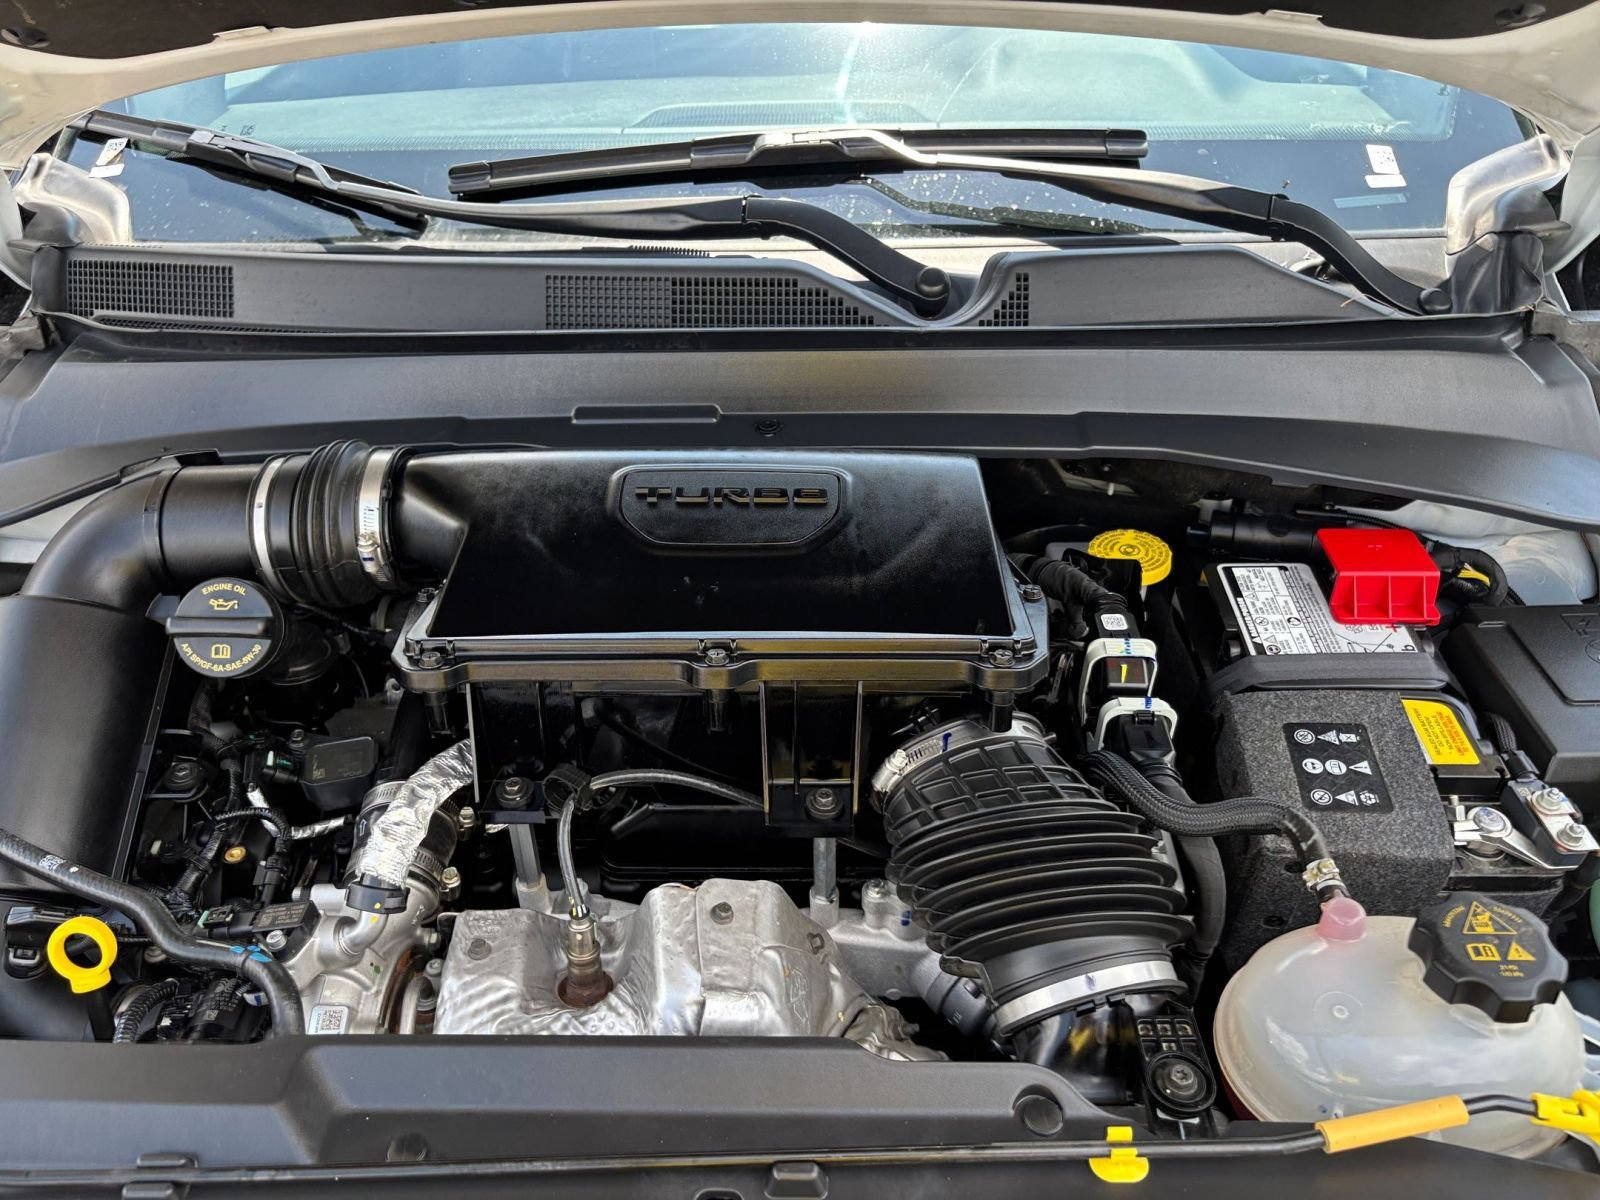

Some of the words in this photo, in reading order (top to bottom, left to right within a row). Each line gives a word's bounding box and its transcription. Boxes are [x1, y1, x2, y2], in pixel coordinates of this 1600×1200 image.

[202, 584, 232, 595] ENGINE
[233, 585, 247, 596] OIL
[181, 643, 191, 656] API
